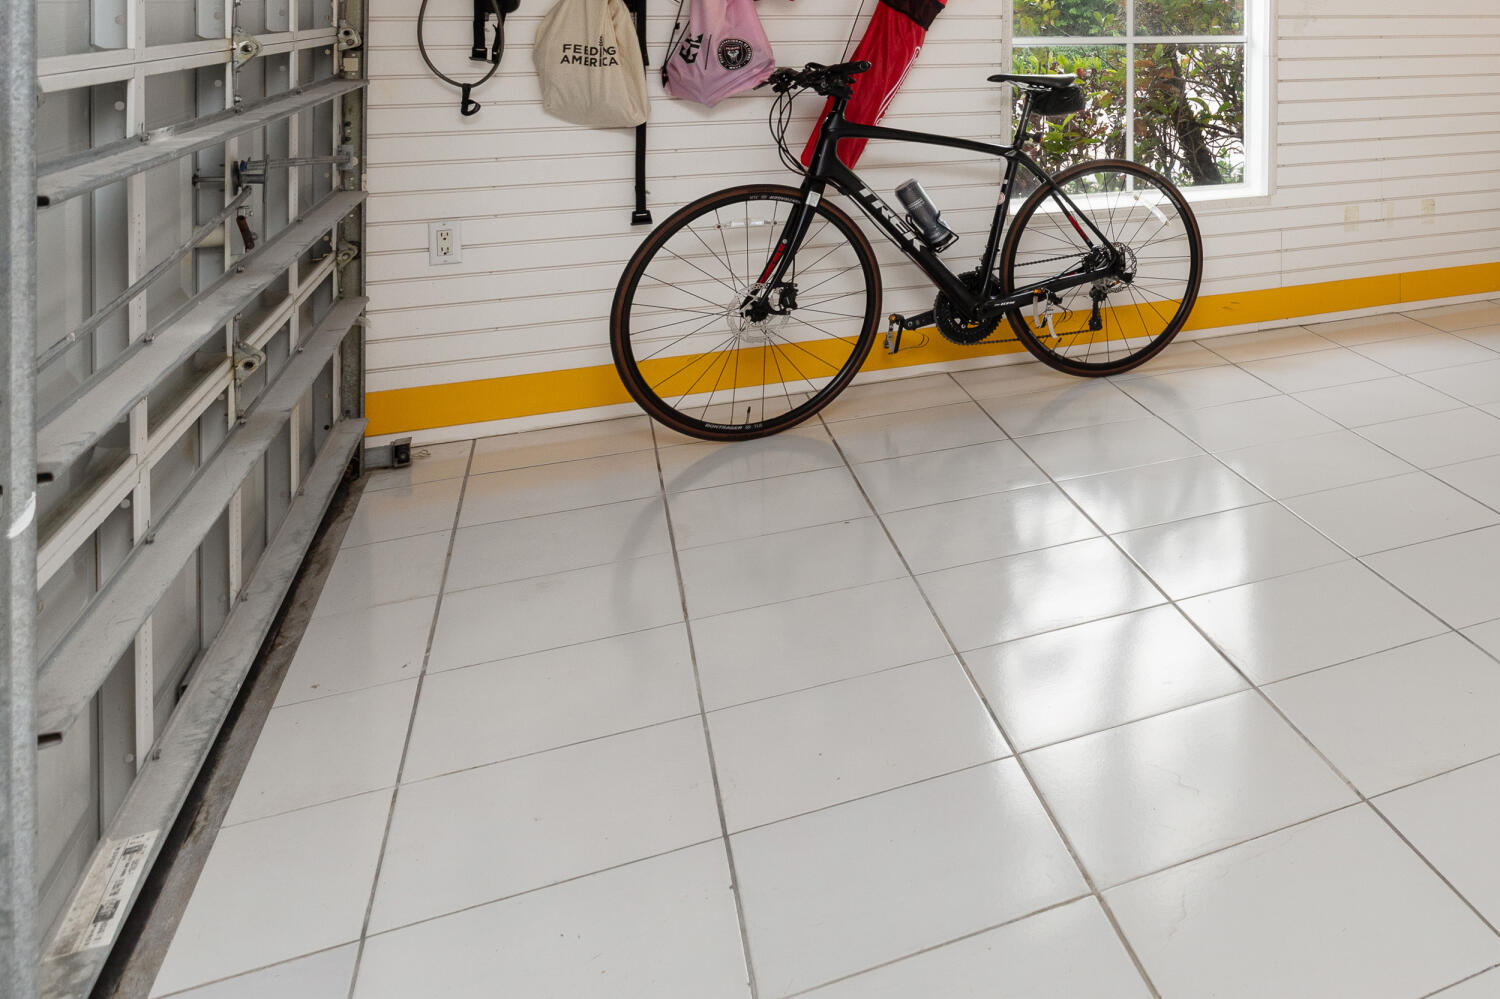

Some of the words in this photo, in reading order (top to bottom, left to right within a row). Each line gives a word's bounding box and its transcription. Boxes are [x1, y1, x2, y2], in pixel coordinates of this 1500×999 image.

[562, 43, 617, 56] FEEDING
[560, 54, 619, 68] AMERICA
[859, 188, 929, 252] TREK
